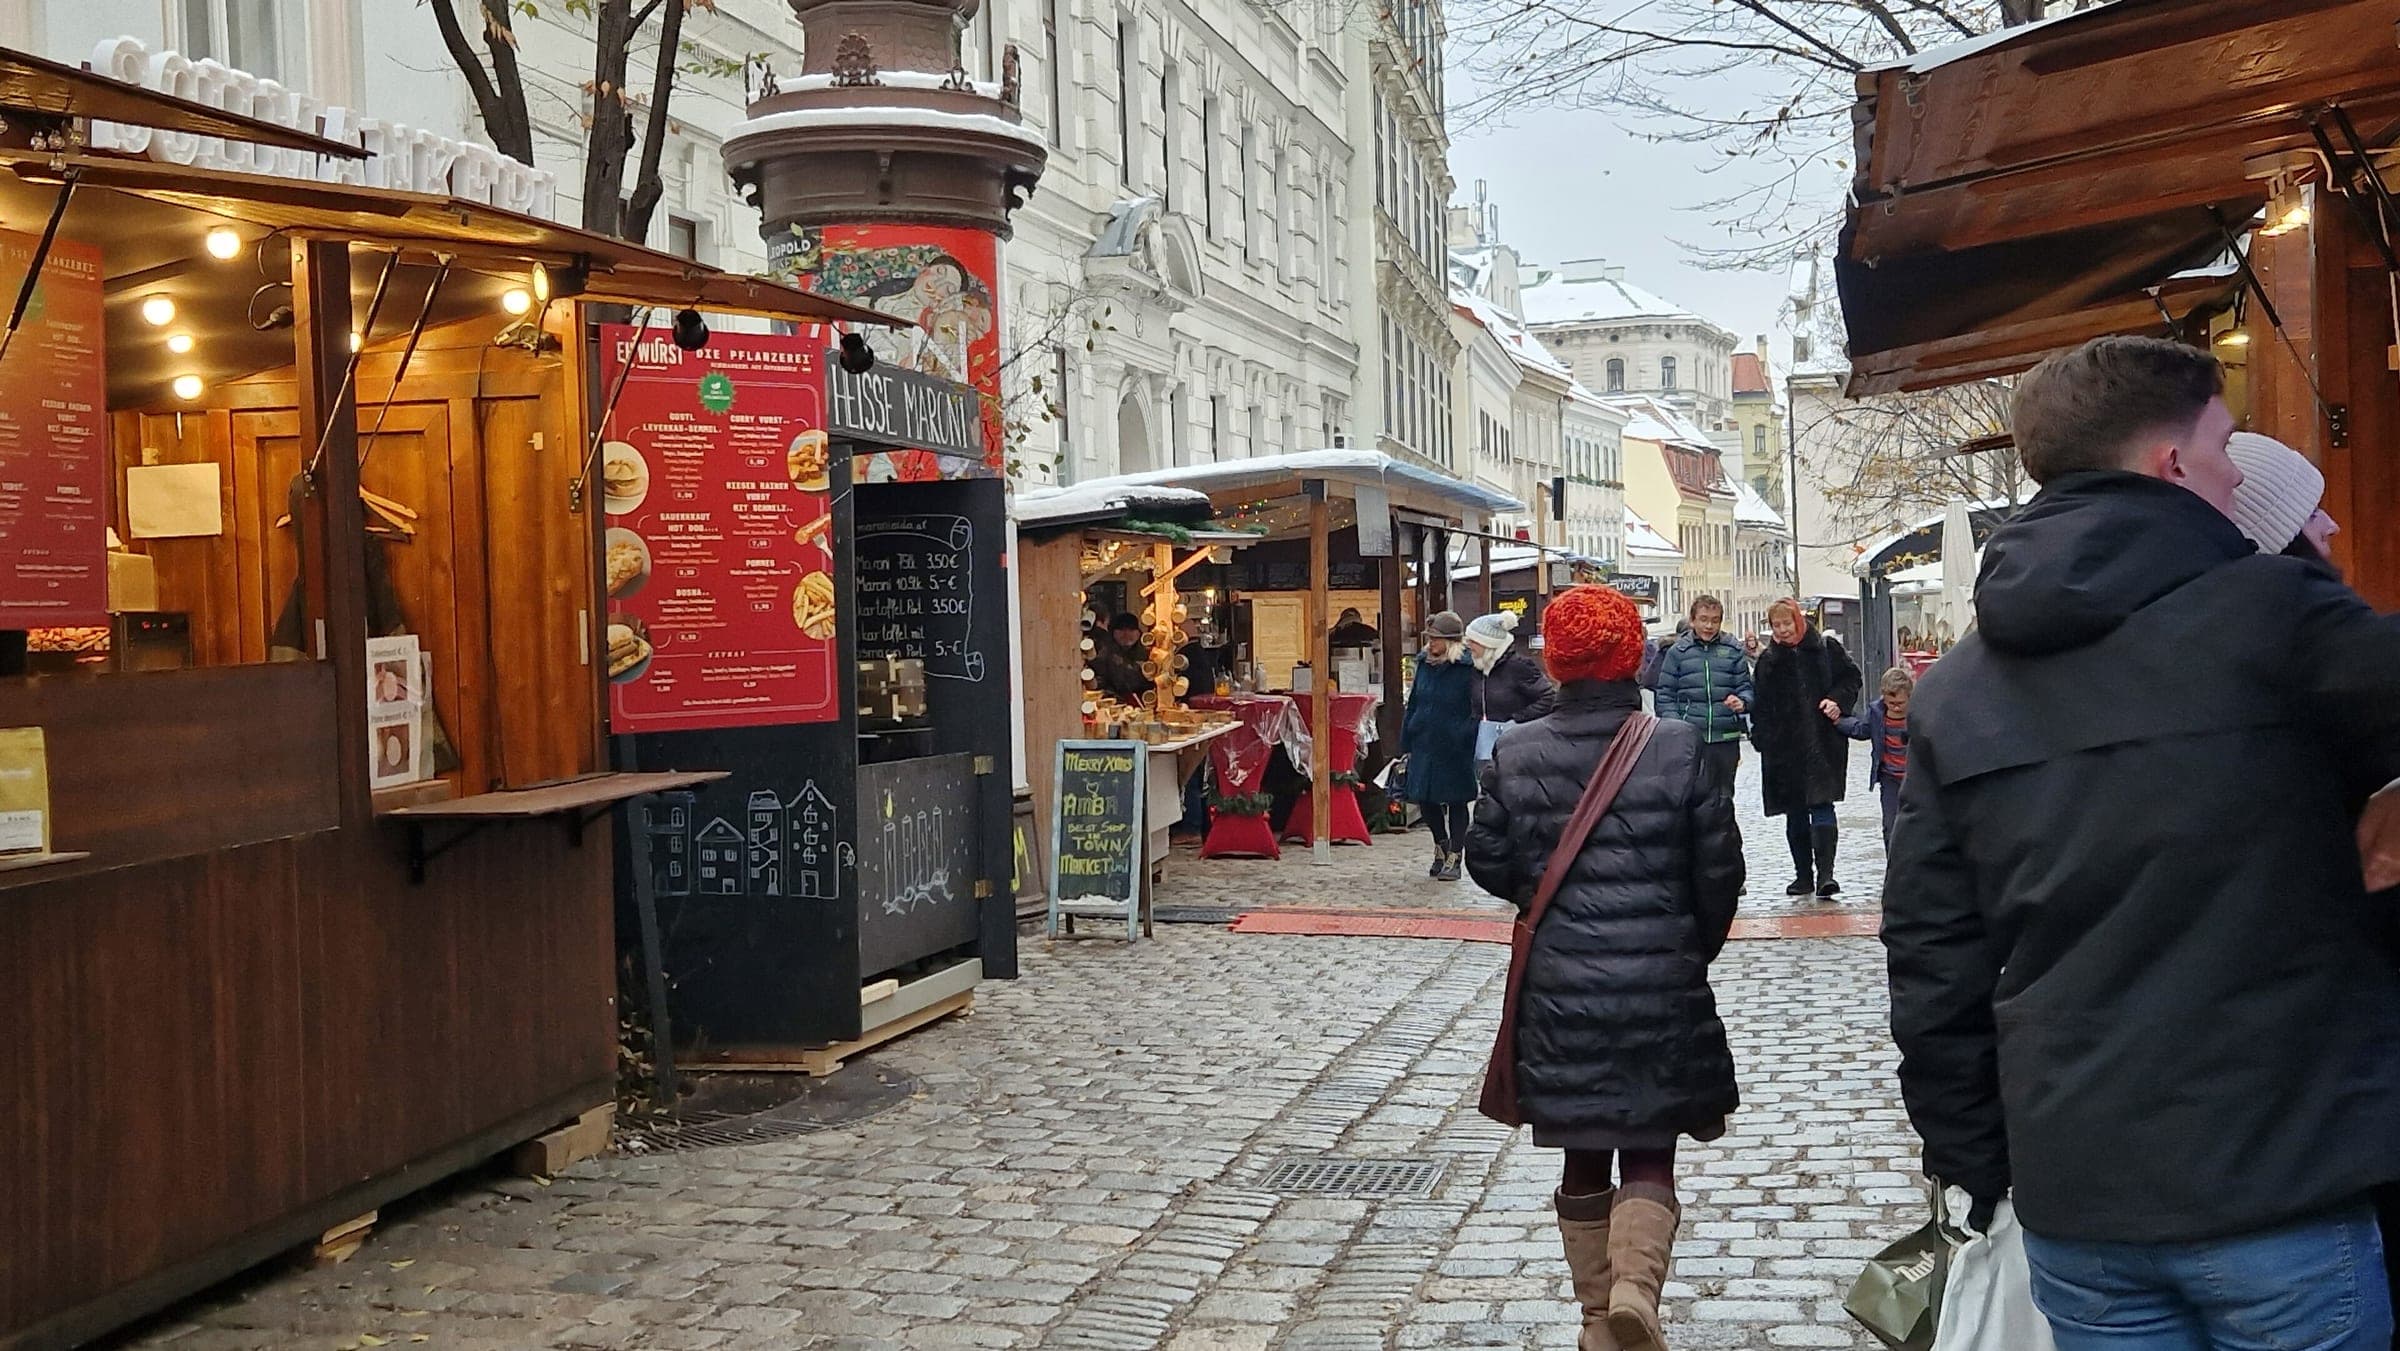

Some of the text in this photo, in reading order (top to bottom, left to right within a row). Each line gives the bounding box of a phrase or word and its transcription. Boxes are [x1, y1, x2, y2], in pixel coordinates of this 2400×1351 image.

[637, 337, 683, 365] WURST
[696, 348, 810, 364] DIE PFLANZEREI
[831, 363, 968, 449] HEISSE MARONI
[730, 415, 755, 423] CURRY
[660, 513, 711, 521] SAUERKRAUT
[1065, 752, 1103, 772] MERRY
